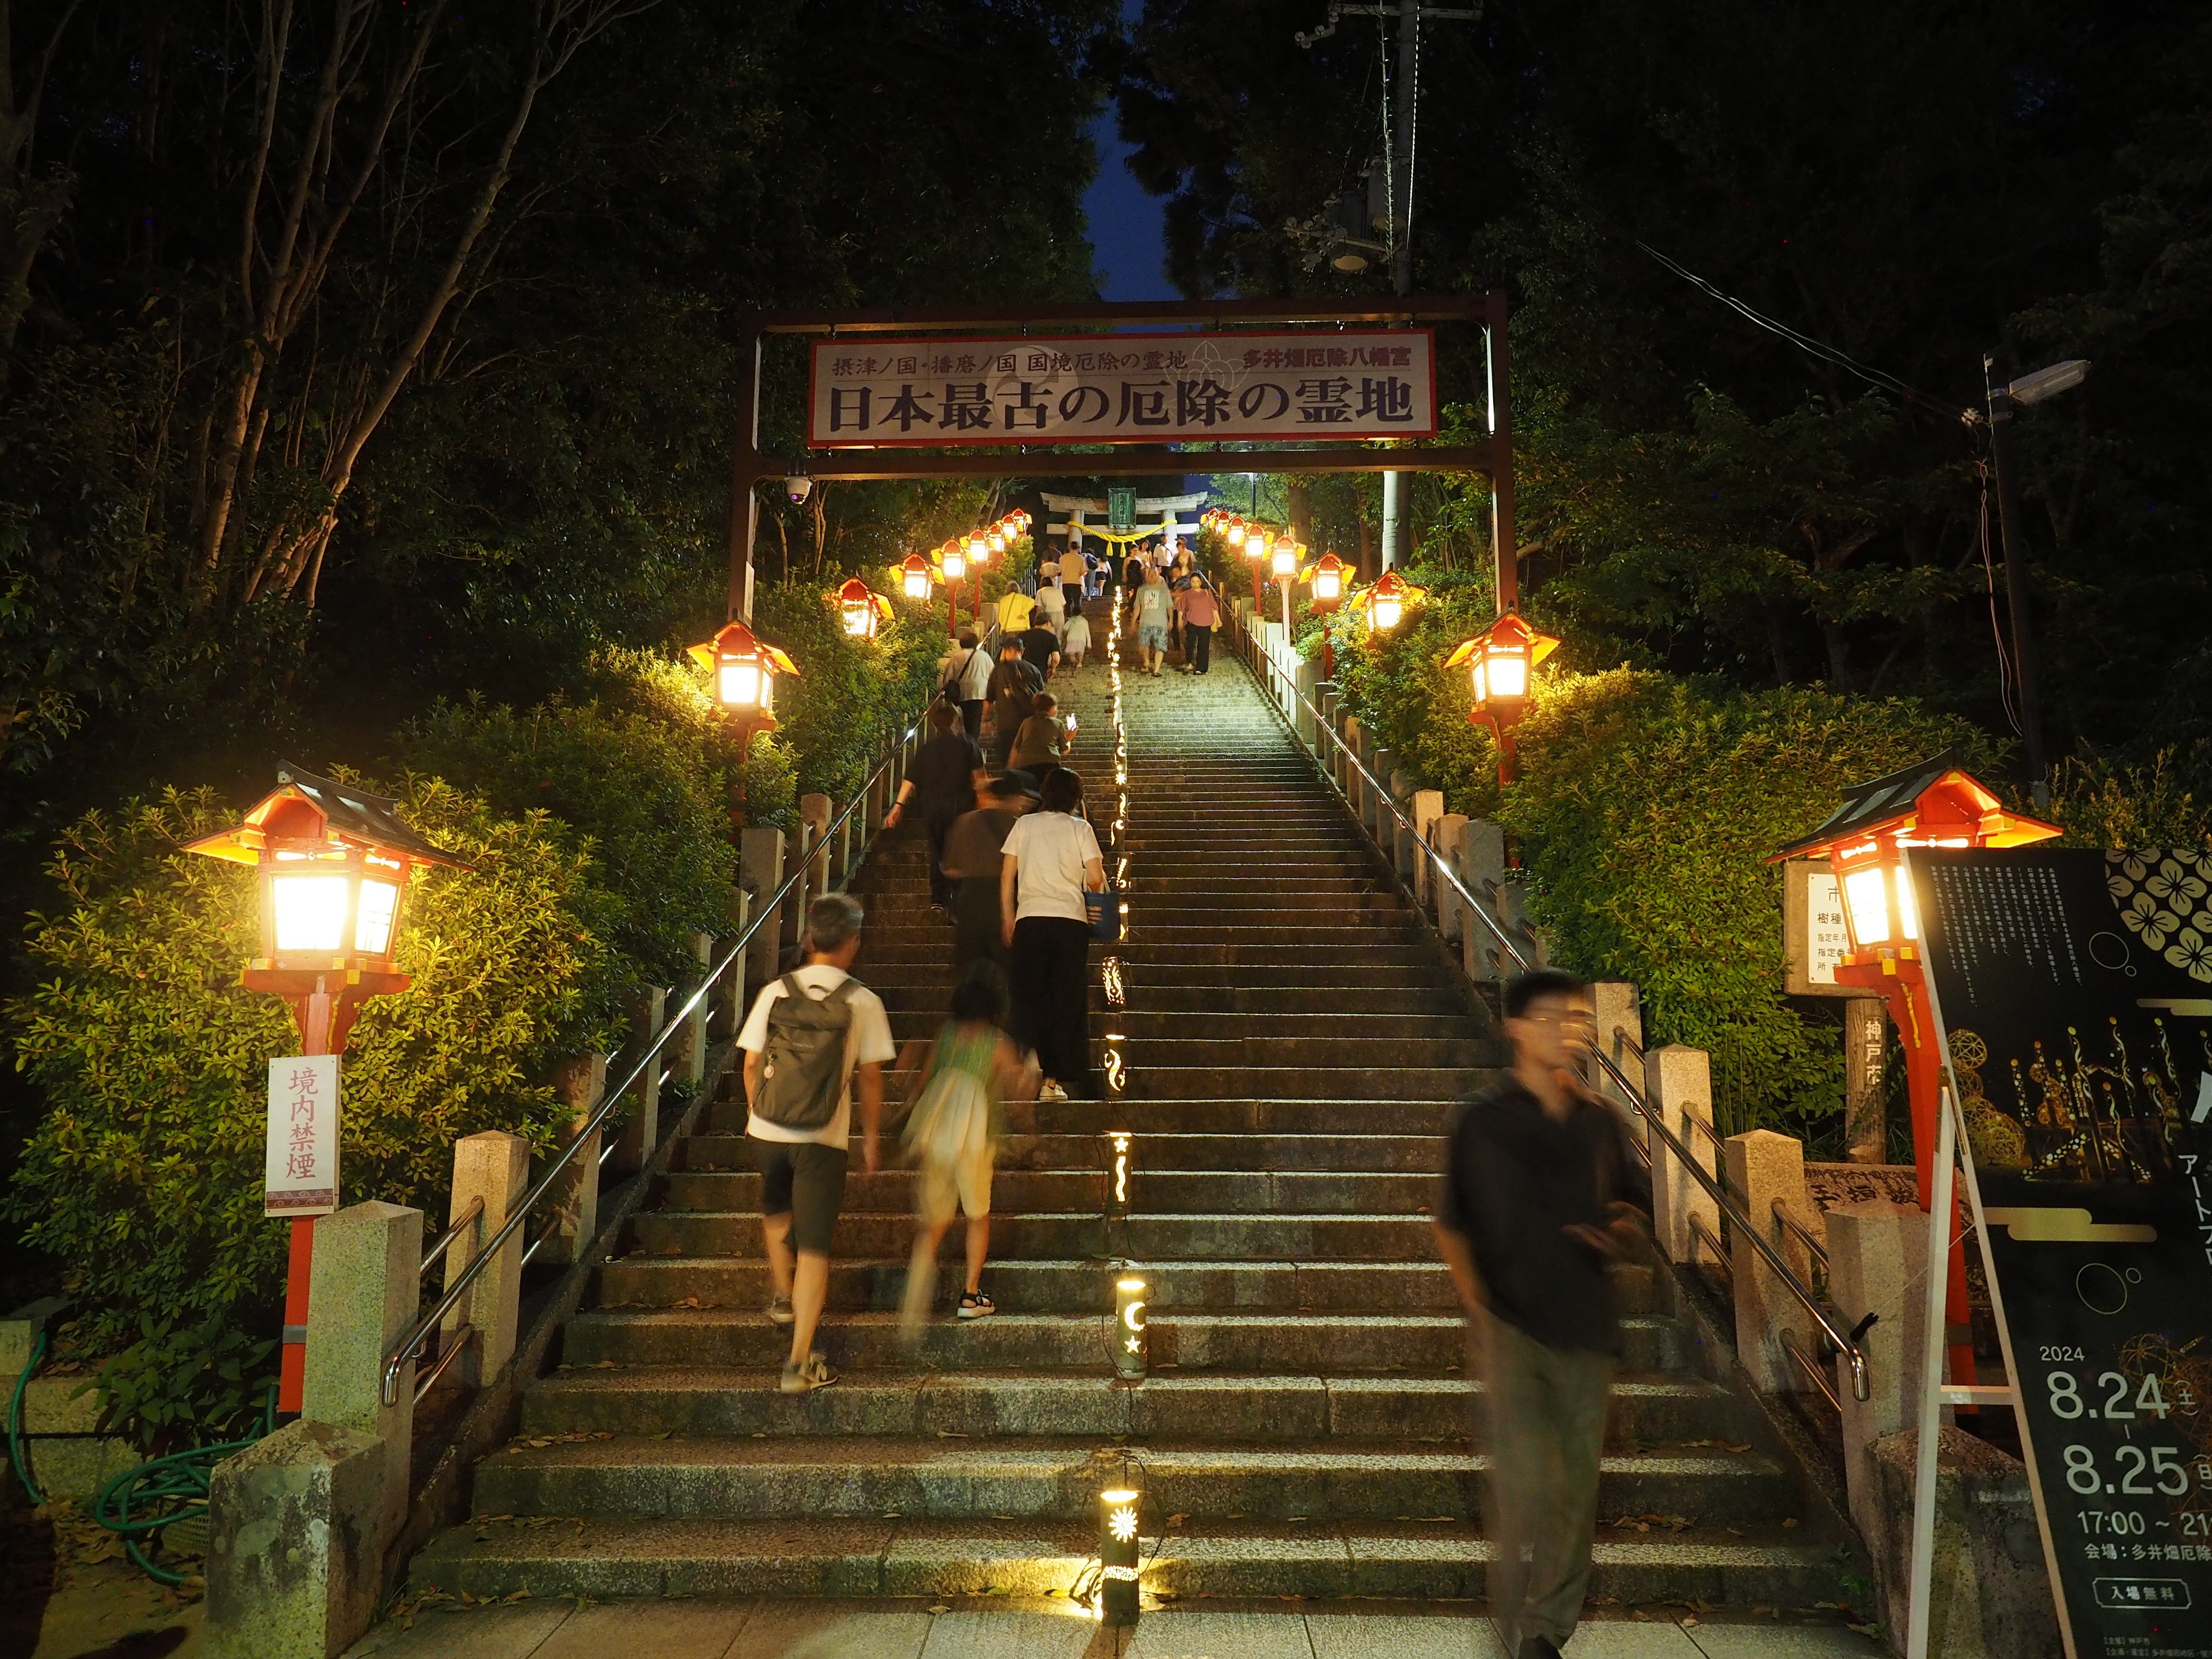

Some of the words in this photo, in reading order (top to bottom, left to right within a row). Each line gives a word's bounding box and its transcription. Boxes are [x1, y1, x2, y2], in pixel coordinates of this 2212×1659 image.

[1028, 350, 1189, 372] 国境厄除の霊地
[1243, 347, 1412, 369] 多井畑厄除八幡宮
[830, 376, 1413, 432] 日本最古の厄除の霊地
[1817, 912, 1842, 925] 樹種
[1865, 1021, 1882, 1085] 神戸市
[285, 1067, 319, 1179] 境内禁煙
[2039, 1346, 2085, 1361] 2024
[2046, 1370, 2170, 1419] 8.24
[2063, 1444, 2189, 1496] 8.25
[2077, 1511, 2146, 1536] 17:00
[2110, 1586, 2175, 1601] 入場無料
